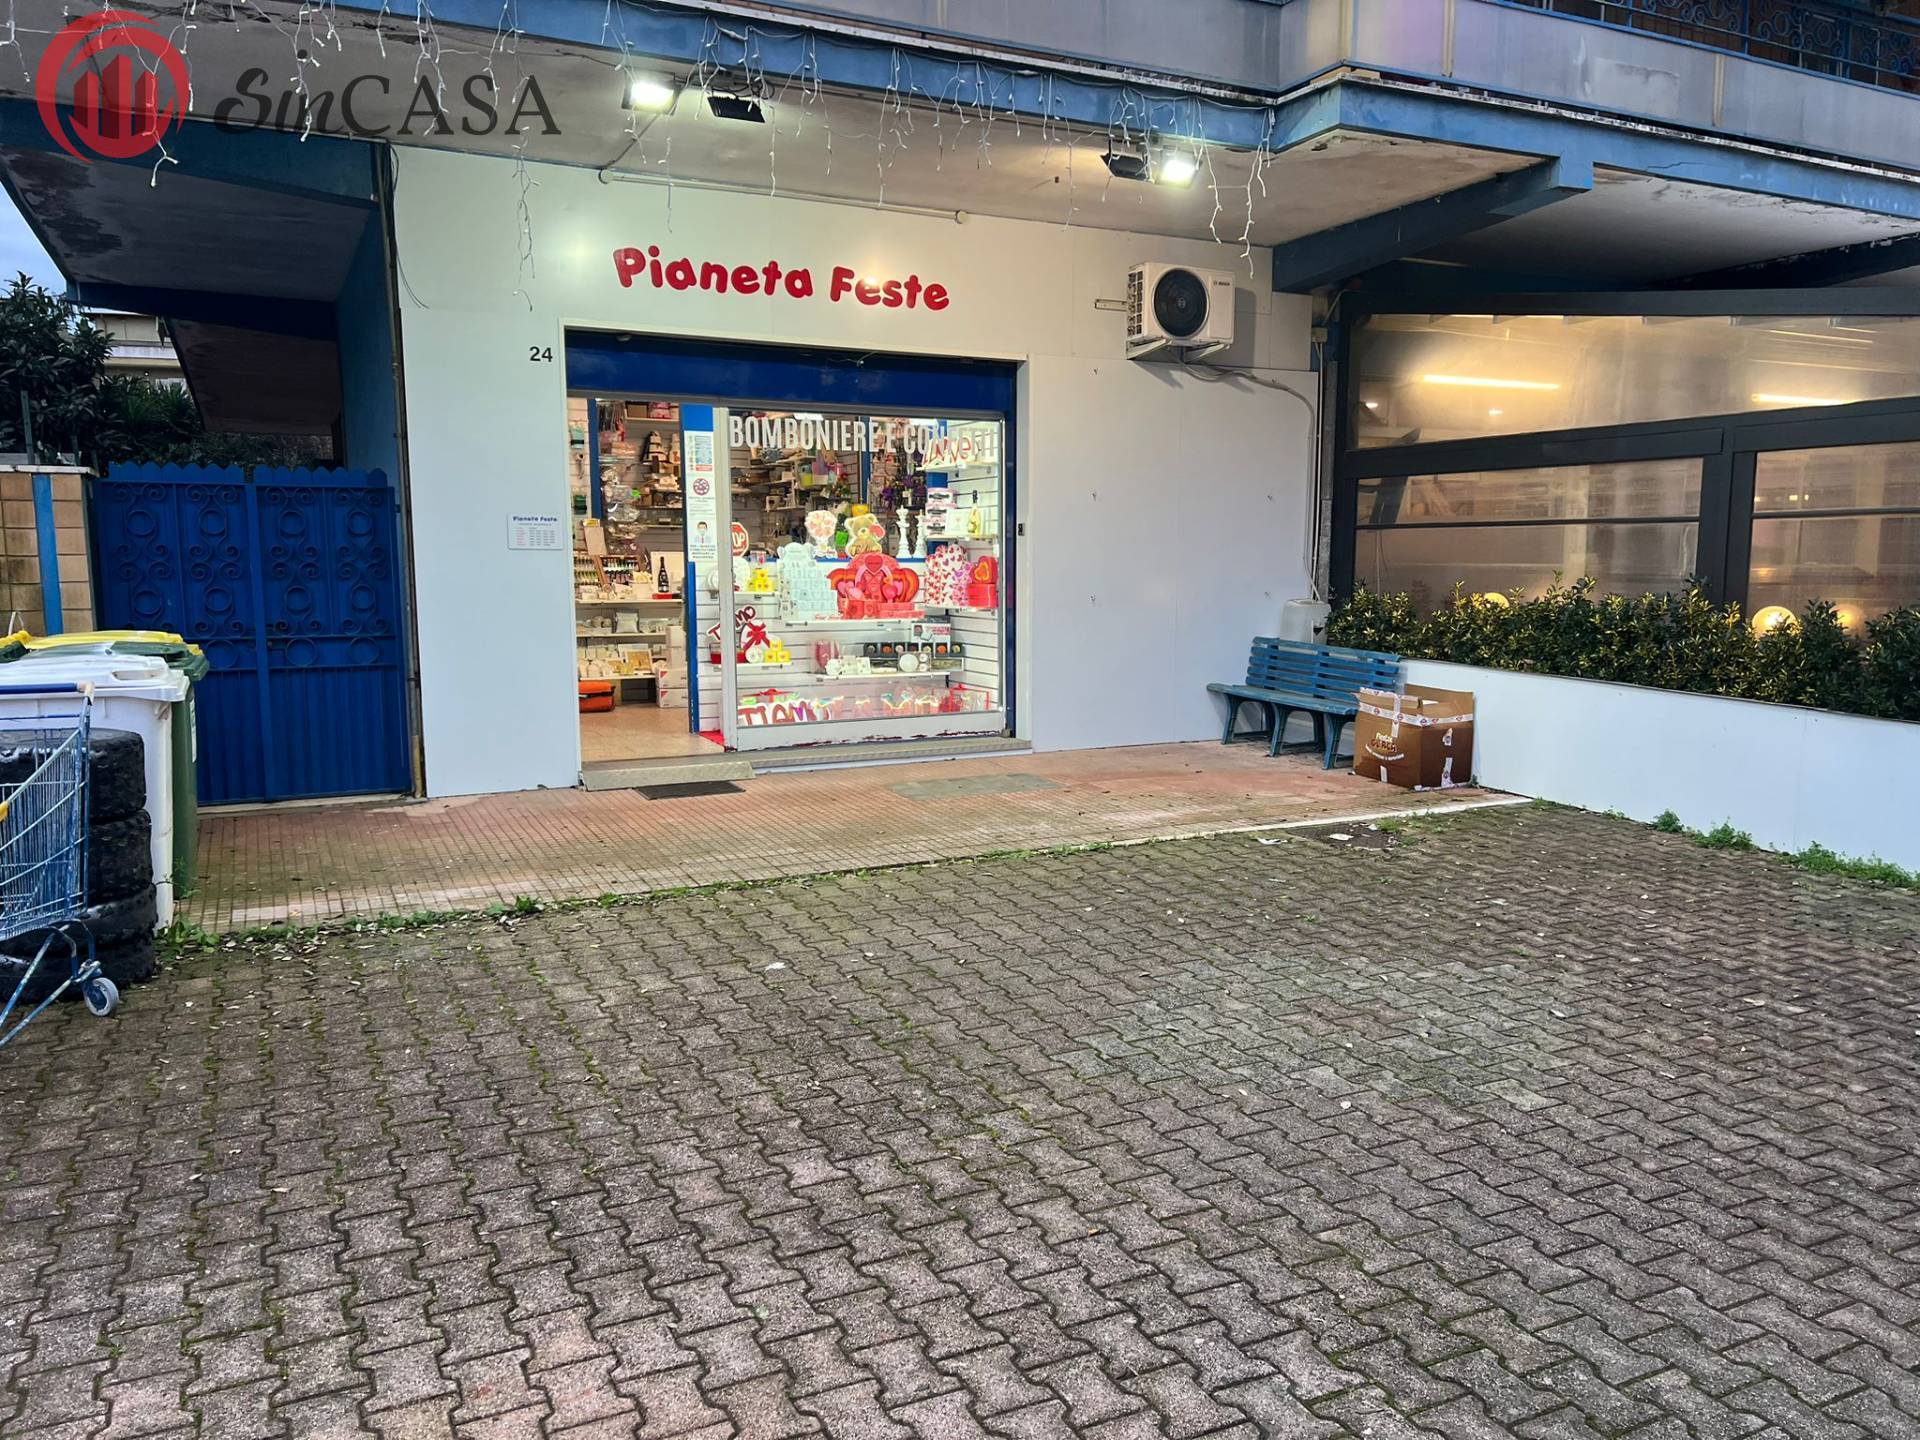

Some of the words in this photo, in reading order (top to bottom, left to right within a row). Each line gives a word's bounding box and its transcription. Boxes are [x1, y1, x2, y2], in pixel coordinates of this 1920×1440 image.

[613, 245, 814, 299] Pianeta
[829, 265, 950, 311] Feste
[528, 346, 554, 362] 24
[729, 415, 880, 453] BOMBONIERE
[885, 423, 898, 453] E
